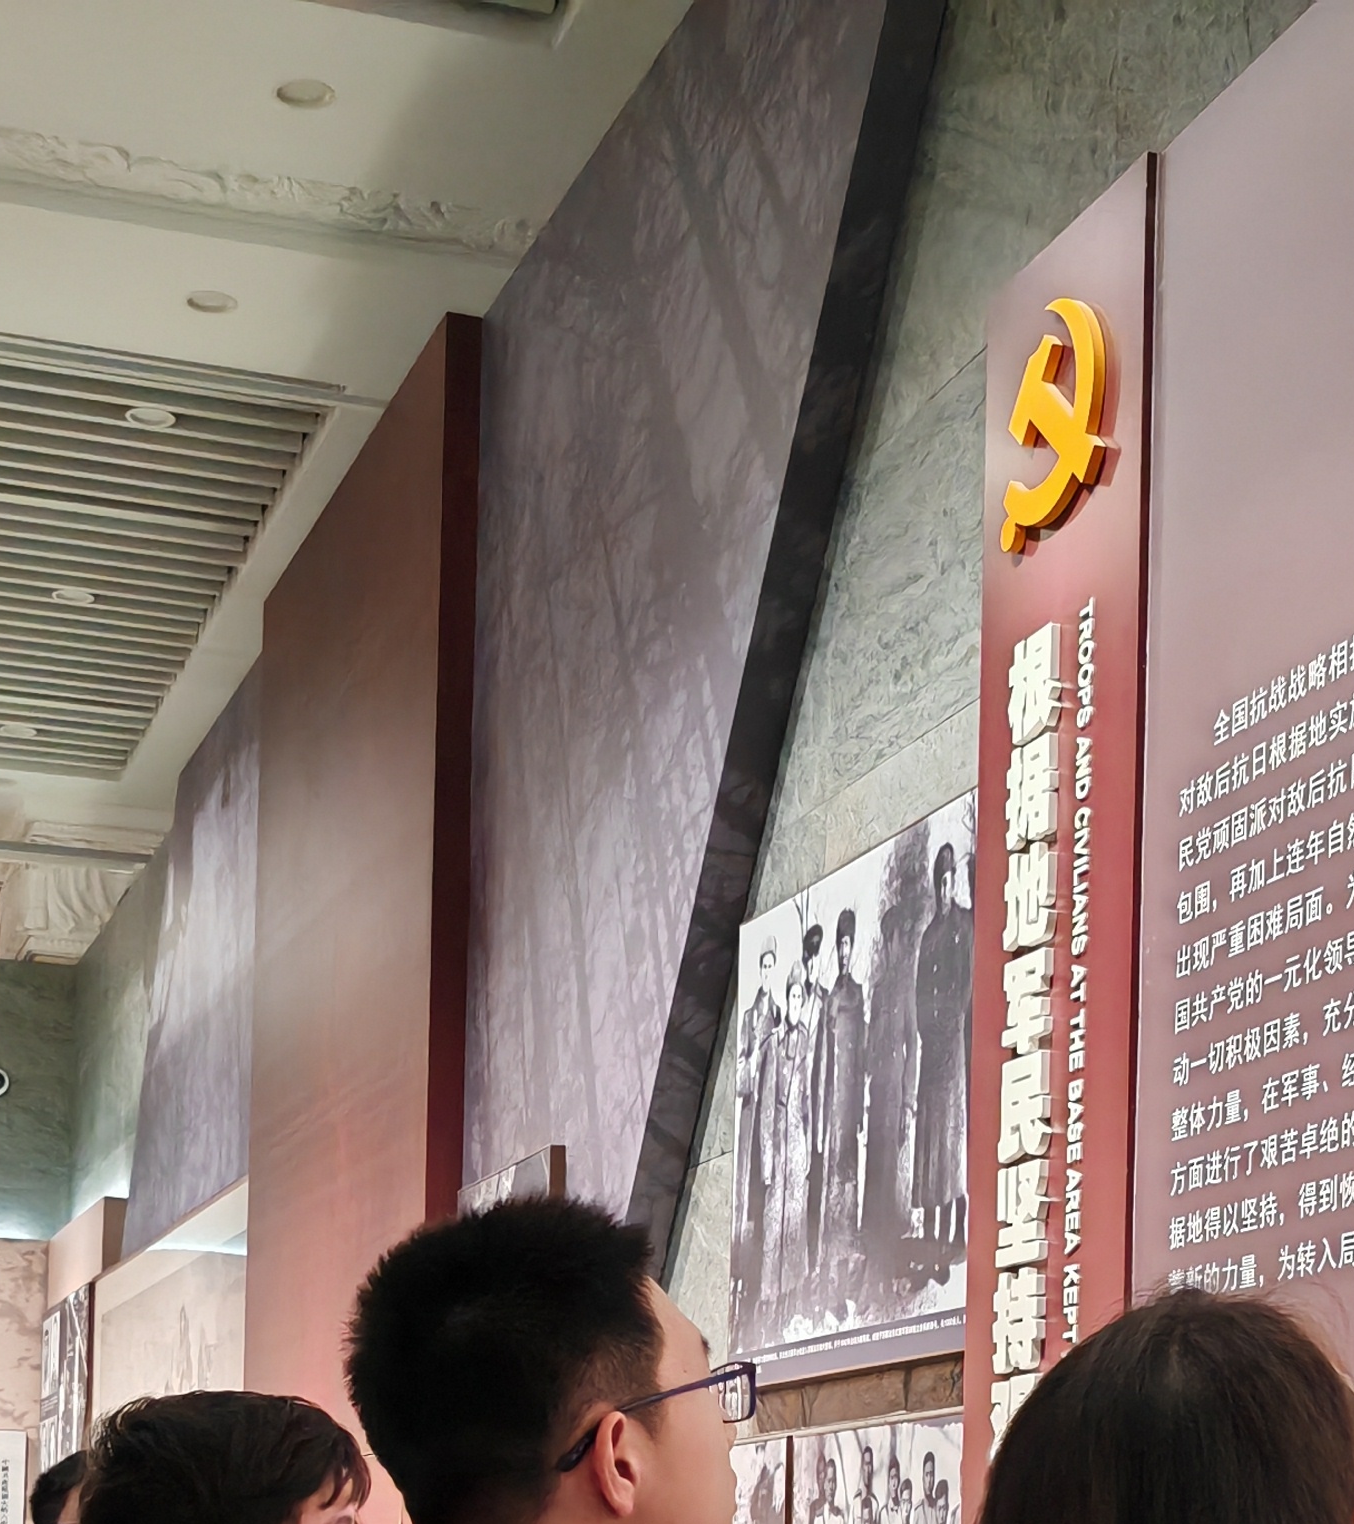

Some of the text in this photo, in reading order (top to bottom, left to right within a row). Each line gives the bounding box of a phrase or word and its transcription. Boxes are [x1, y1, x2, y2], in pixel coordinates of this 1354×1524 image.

[1075, 597, 1096, 729] TROOPS
[1075, 736, 1094, 801] AND
[1071, 806, 1093, 957] CIVILIANS
[1069, 964, 1087, 1003] AT
[1068, 1008, 1086, 1073] THE
[1066, 1079, 1085, 1164] BASE
[1063, 1169, 1083, 1255] AREA
[1062, 1264, 1082, 1344] KEPT
